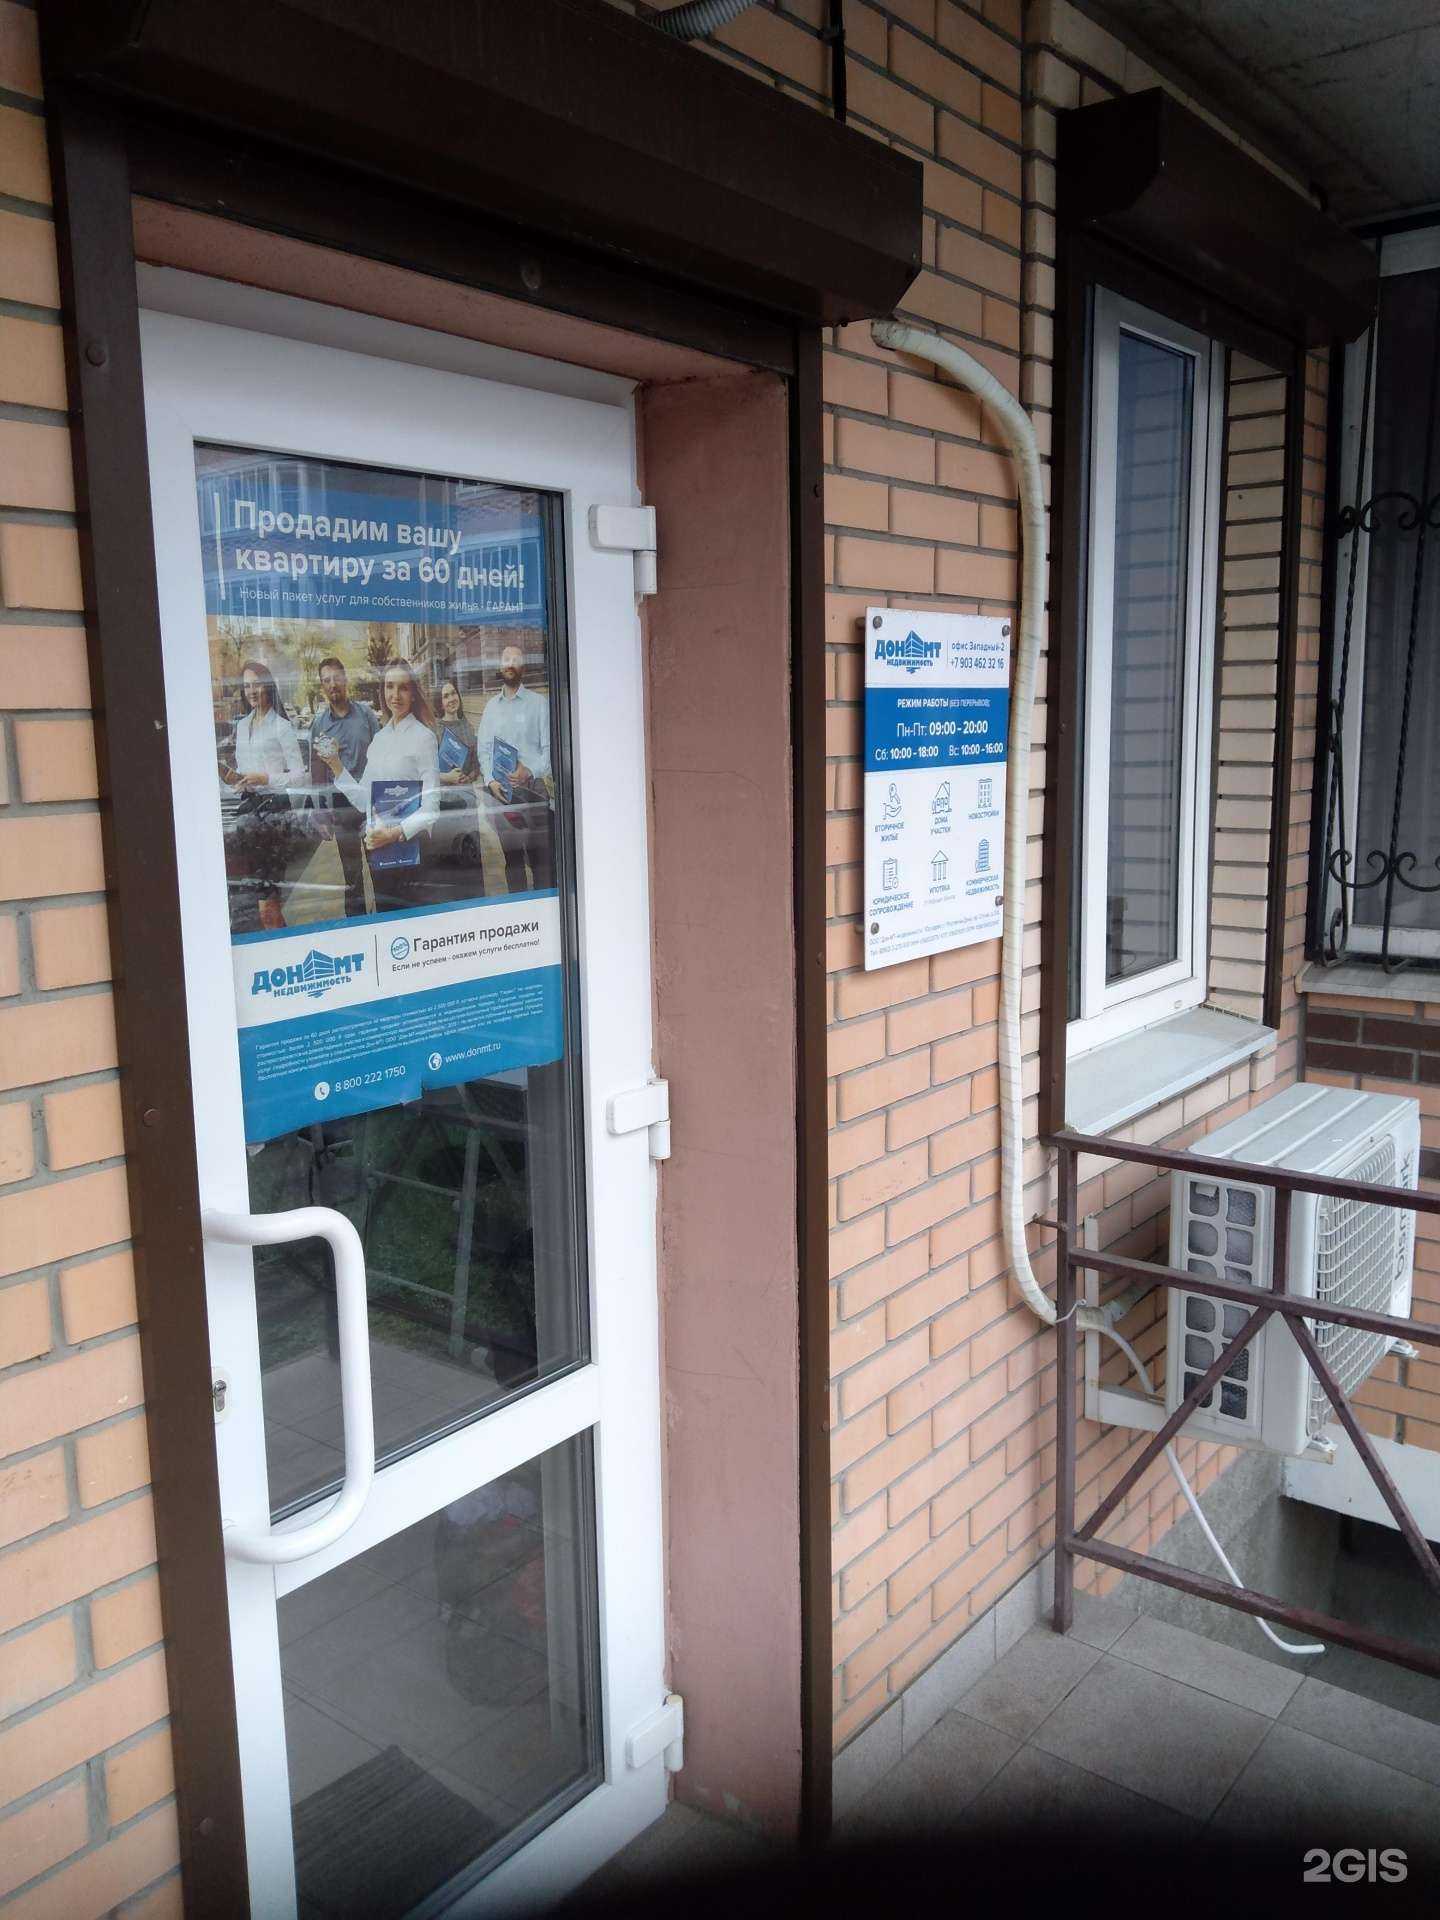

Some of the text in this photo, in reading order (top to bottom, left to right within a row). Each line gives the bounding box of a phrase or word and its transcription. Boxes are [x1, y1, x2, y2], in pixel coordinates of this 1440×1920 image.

[234, 499, 463, 555] Продадим вашу
[235, 548, 526, 590] квартиру за 60 дней!
[239, 587, 280, 601] Новый
[282, 591, 313, 602] пакет
[315, 593, 347, 608] услуг
[349, 596, 370, 606] для
[371, 594, 447, 610] собственников
[960, 657, 973, 669] 903
[897, 699, 922, 708] РЕЖИМ
[922, 698, 949, 708] РАБОТЫ
[897, 723, 928, 737] Пн-Пт:
[929, 721, 956, 736] 09:00
[963, 720, 989, 735] 20:00
[875, 749, 889, 761] Сб:
[890, 747, 912, 760] 10:00
[918, 745, 939, 758] 18:00
[961, 744, 980, 756] 10:00
[985, 742, 1004, 754] 16:00
[413, 921, 539, 952] Гарантия продажи
[392, 962, 410, 972] Если
[411, 960, 421, 968] не
[422, 954, 447, 967] успеем
[451, 950, 477, 961] окажем
[478, 944, 502, 956] услуги
[503, 939, 540, 951] бесплатно!
[273, 976, 352, 998] НЕДВИЖИМОСТЬ
[445, 1042, 501, 1062] www.donmt.ru
[335, 1065, 406, 1092] 8 800 222 1750
